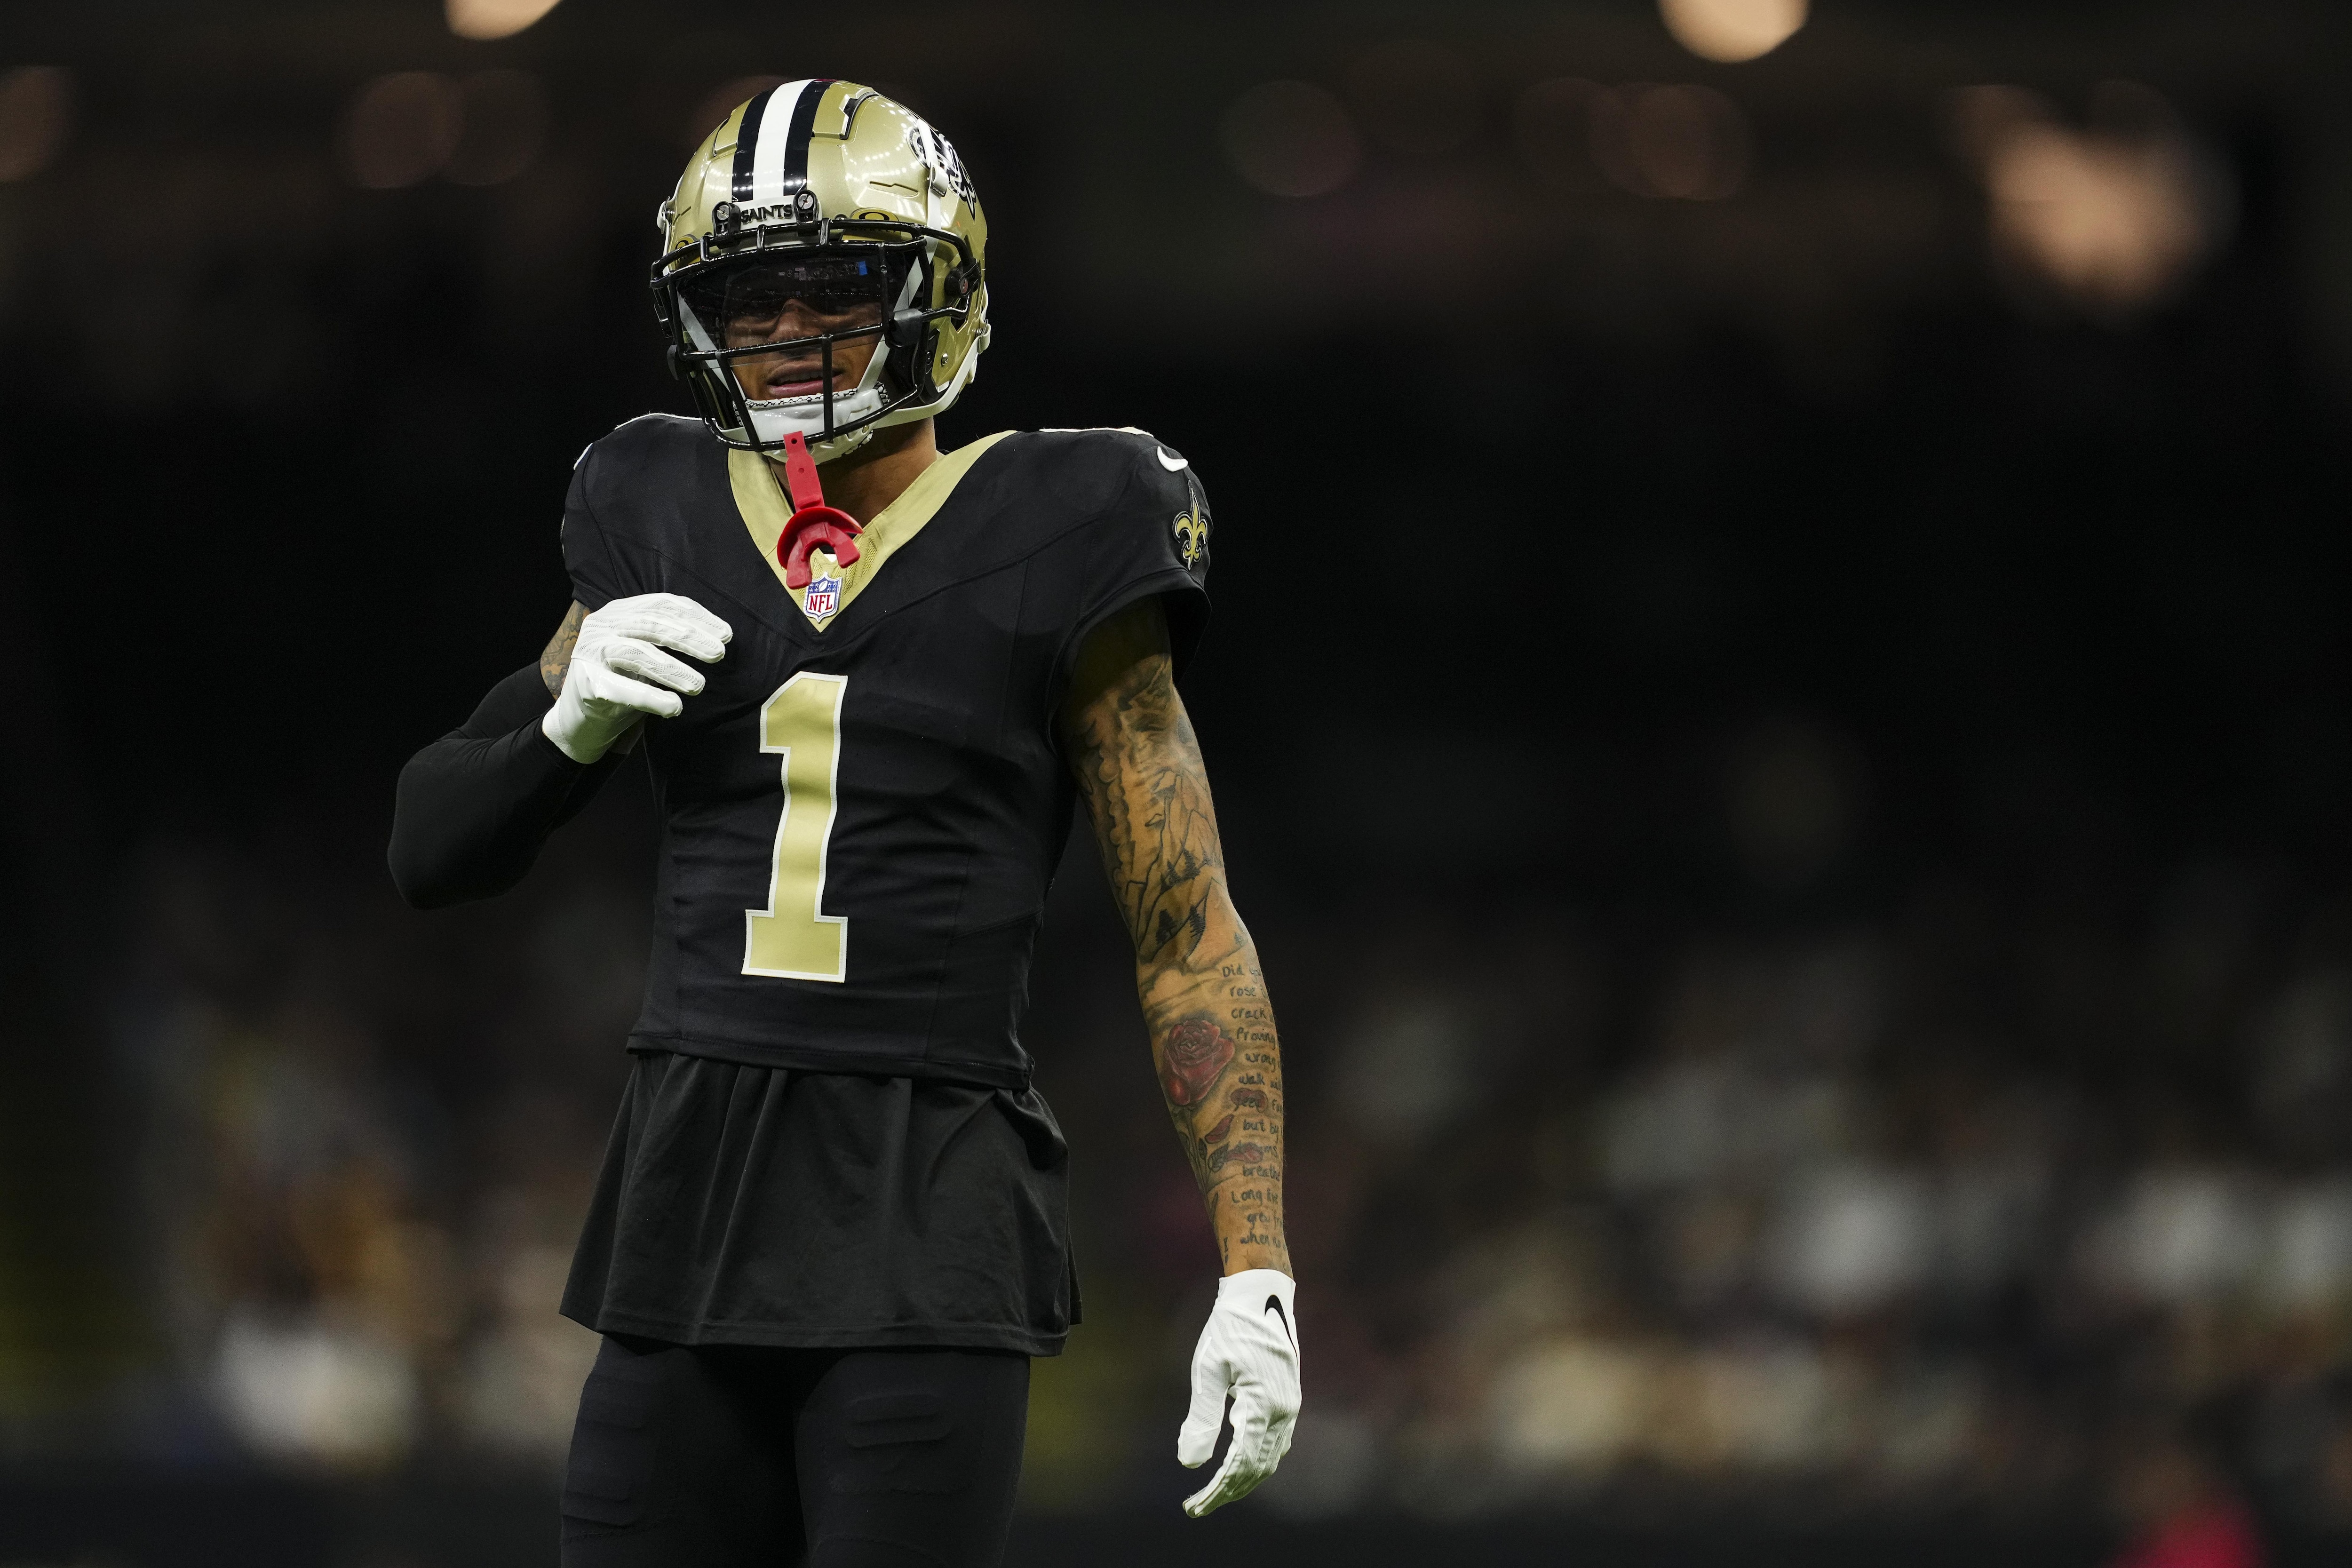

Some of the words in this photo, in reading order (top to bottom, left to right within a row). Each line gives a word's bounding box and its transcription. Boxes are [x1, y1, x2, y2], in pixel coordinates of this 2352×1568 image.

[740, 203, 794, 224] SAINTS
[808, 594, 833, 613] NFL
[741, 671, 848, 983] 1
[1222, 963, 1245, 978] Did
